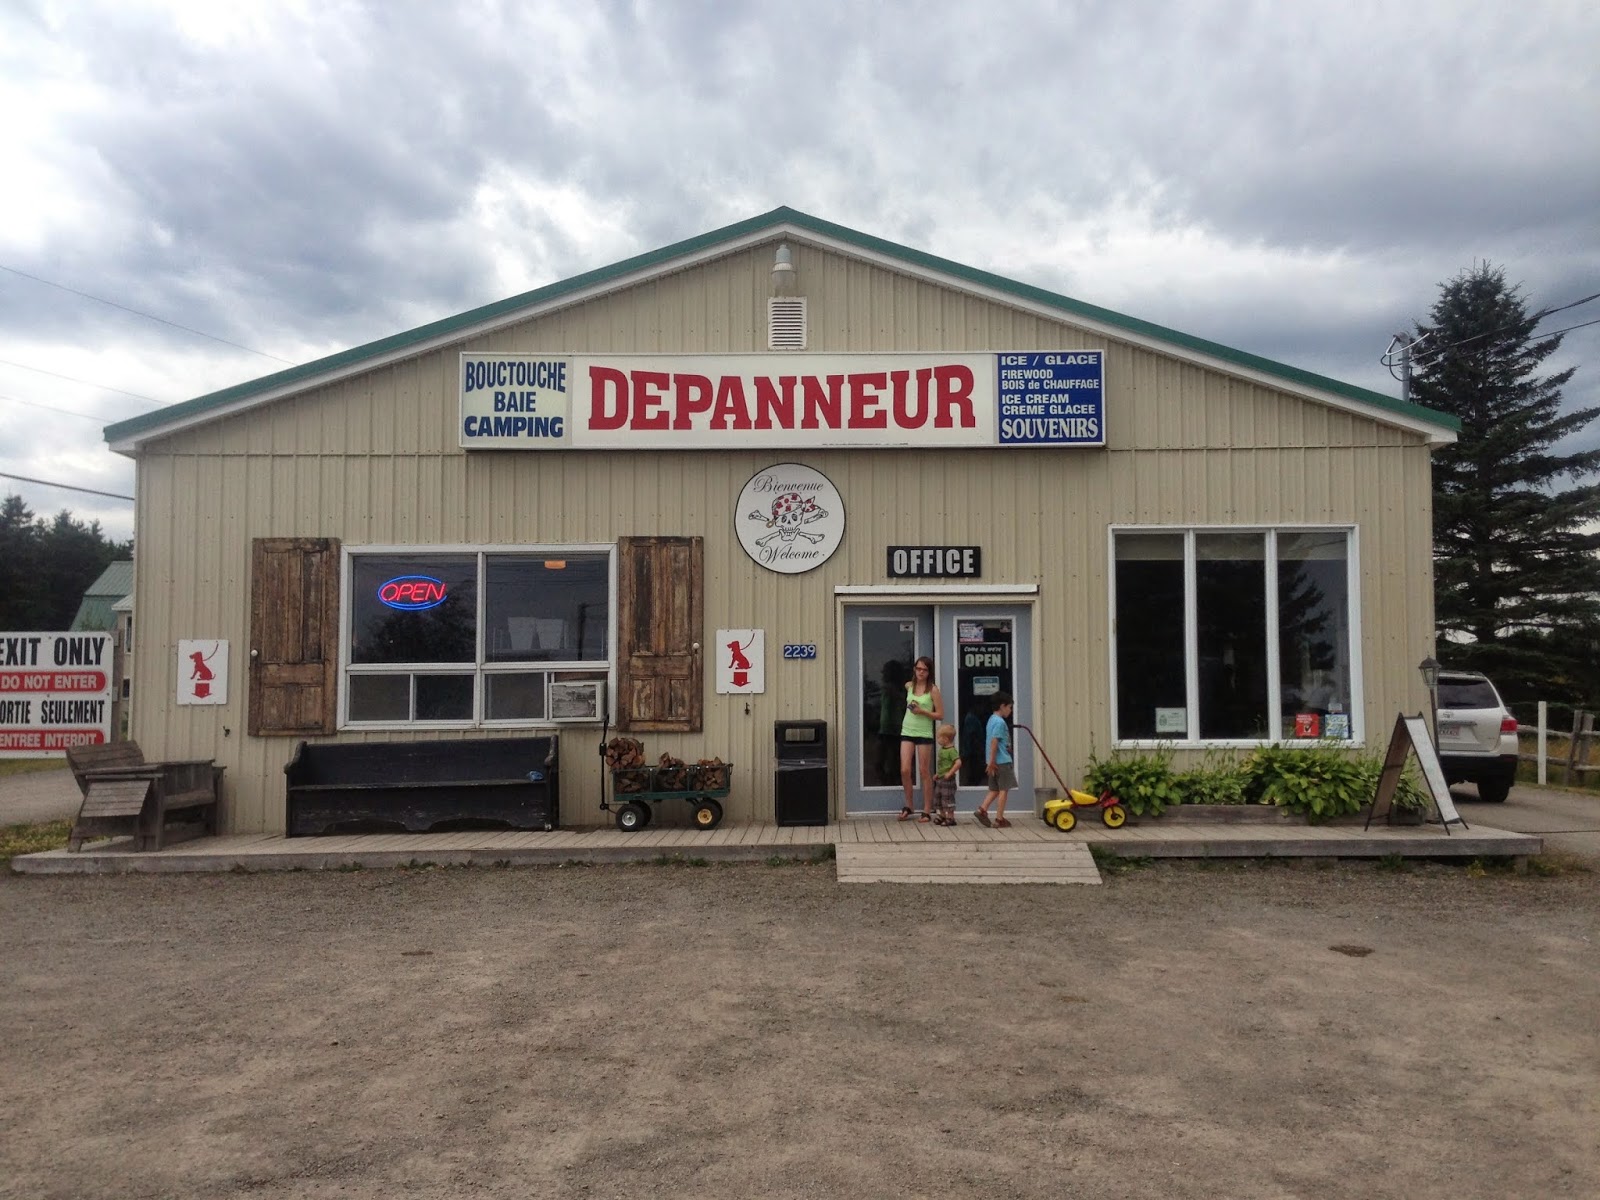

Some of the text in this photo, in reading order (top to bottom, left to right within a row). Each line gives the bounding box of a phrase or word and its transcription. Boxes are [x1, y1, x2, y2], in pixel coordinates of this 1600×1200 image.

[1001, 355, 1097, 366] ICE / GLACE
[465, 361, 566, 393] BOUCTOUCHE
[1002, 369, 1053, 380] FIREWOOD
[1002, 379, 1099, 390] BOIS de CHAUFFAGE
[494, 391, 536, 413] BAIE
[588, 364, 976, 431] DEPANNEUR
[1002, 394, 1069, 404] ICE CREAM
[1003, 404, 1096, 415] CREME GLACEE
[464, 415, 564, 438] CAMPING
[1002, 418, 1099, 439] SOUVENIRS
[753, 474, 824, 493] Bienvenue
[759, 543, 820, 564] Welcome
[893, 549, 974, 575] OFFICE
[381, 583, 446, 601] OPEN
[54, 637, 105, 666] ONLY
[784, 645, 816, 658] 2239
[965, 653, 1002, 667] OPEN
[1, 675, 97, 690] DO NOT ENTER
[41, 700, 105, 724] SEULEMENT
[0, 733, 97, 747] ENTREE INTERDIT
